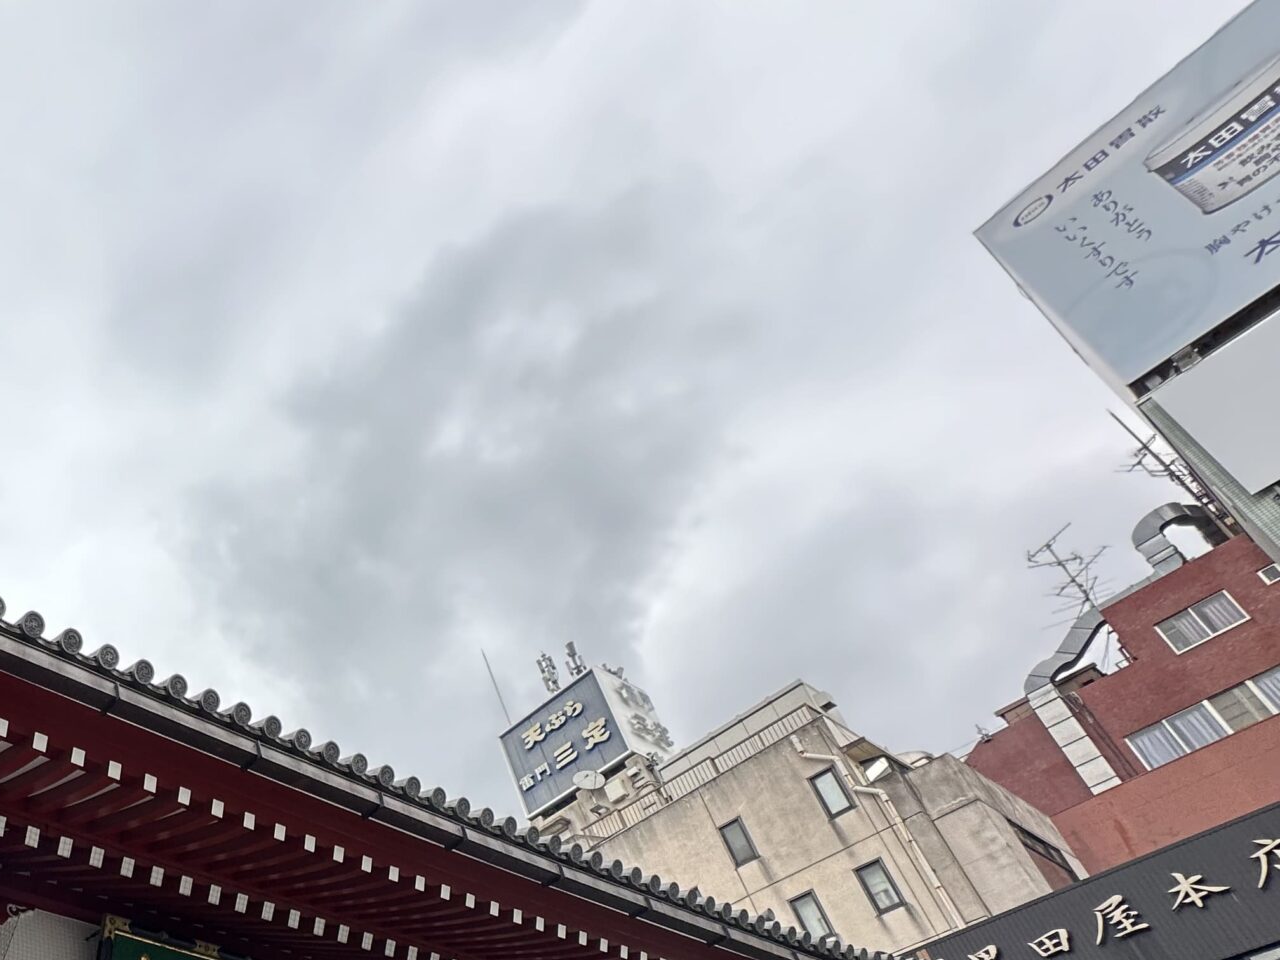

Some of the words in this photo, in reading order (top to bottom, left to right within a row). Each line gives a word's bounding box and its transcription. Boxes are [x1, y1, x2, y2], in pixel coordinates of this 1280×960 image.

[1091, 190, 1153, 242] ありがとう
[1055, 217, 1140, 289] いいくすりです
[519, 762, 551, 791] 雷門
[554, 717, 611, 770] 三定
[520, 700, 583, 750] 天ぷら
